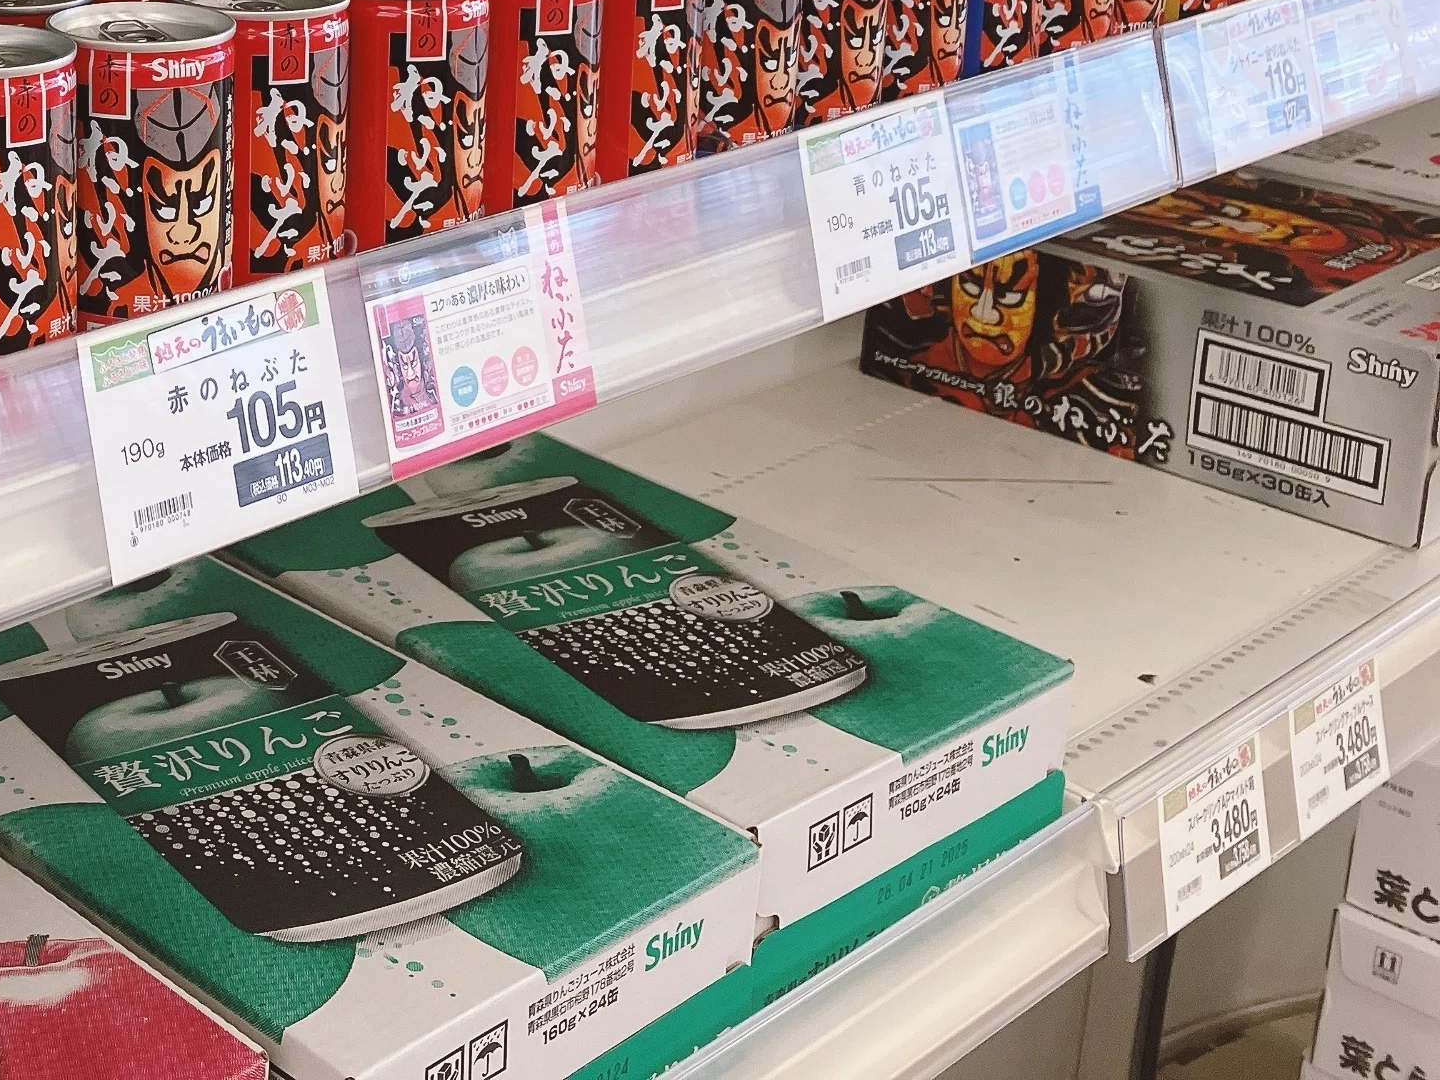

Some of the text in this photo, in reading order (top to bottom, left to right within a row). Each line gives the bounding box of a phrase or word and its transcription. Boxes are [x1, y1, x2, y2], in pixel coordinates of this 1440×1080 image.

[151, 57, 206, 82] Shiny
[632, 13, 687, 168] ねぶた
[518, 38, 577, 197] ねぶた
[391, 65, 454, 230] ねぶた
[254, 88, 316, 259] ねぶた
[826, 213, 854, 233] 190g
[889, 176, 950, 229] 105円
[155, 305, 275, 365] 地元のうまいもの
[1201, 309, 1315, 354] 果汁100%
[1347, 347, 1418, 389] Shiny
[121, 438, 165, 465] 190g
[180, 380, 326, 472] 本体価格 105円
[276, 493, 288, 504] 30
[461, 506, 528, 528] Shiny
[479, 554, 700, 618] 贅沢りんご
[96, 650, 172, 681] Shiny
[92, 708, 362, 801] 贅沢りんご
[981, 725, 1030, 767] Shiny
[1336, 715, 1378, 765] 3,480円
[179, 772, 241, 799] Premium
[244, 761, 282, 788] apple
[900, 778, 962, 821] 160g×24缶
[397, 820, 502, 874] 果汁100%
[644, 918, 705, 972] Shiny
[542, 986, 619, 1045] 160g×24缶
